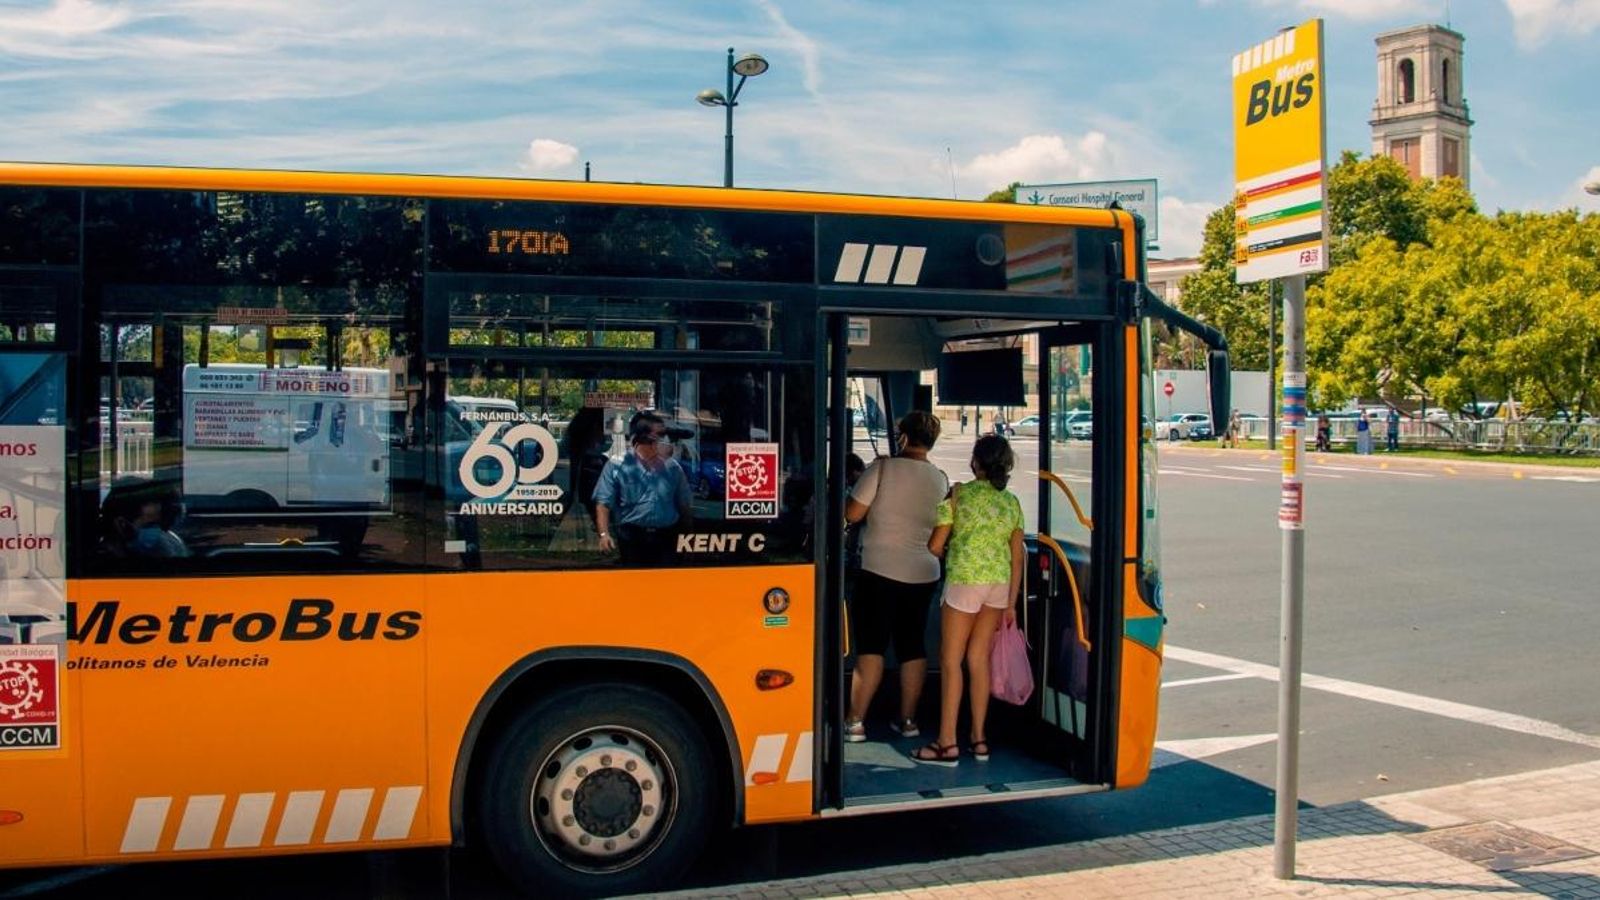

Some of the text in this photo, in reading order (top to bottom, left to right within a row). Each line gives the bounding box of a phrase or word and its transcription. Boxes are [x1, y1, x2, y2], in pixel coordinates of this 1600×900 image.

[1245, 72, 1315, 127] Bus
[1081, 190, 1112, 205] Hospital
[1114, 189, 1144, 202] General
[276, 380, 350, 393] MORENO
[459, 421, 559, 498] 60
[460, 503, 563, 515] ANIVERSARIO
[731, 502, 773, 514] ACCM
[677, 532, 766, 552] KENT C
[67, 598, 422, 645] MetroBus
[153, 656, 177, 669] de
[186, 653, 270, 668] Valencia
[0, 728, 52, 745] CCM
